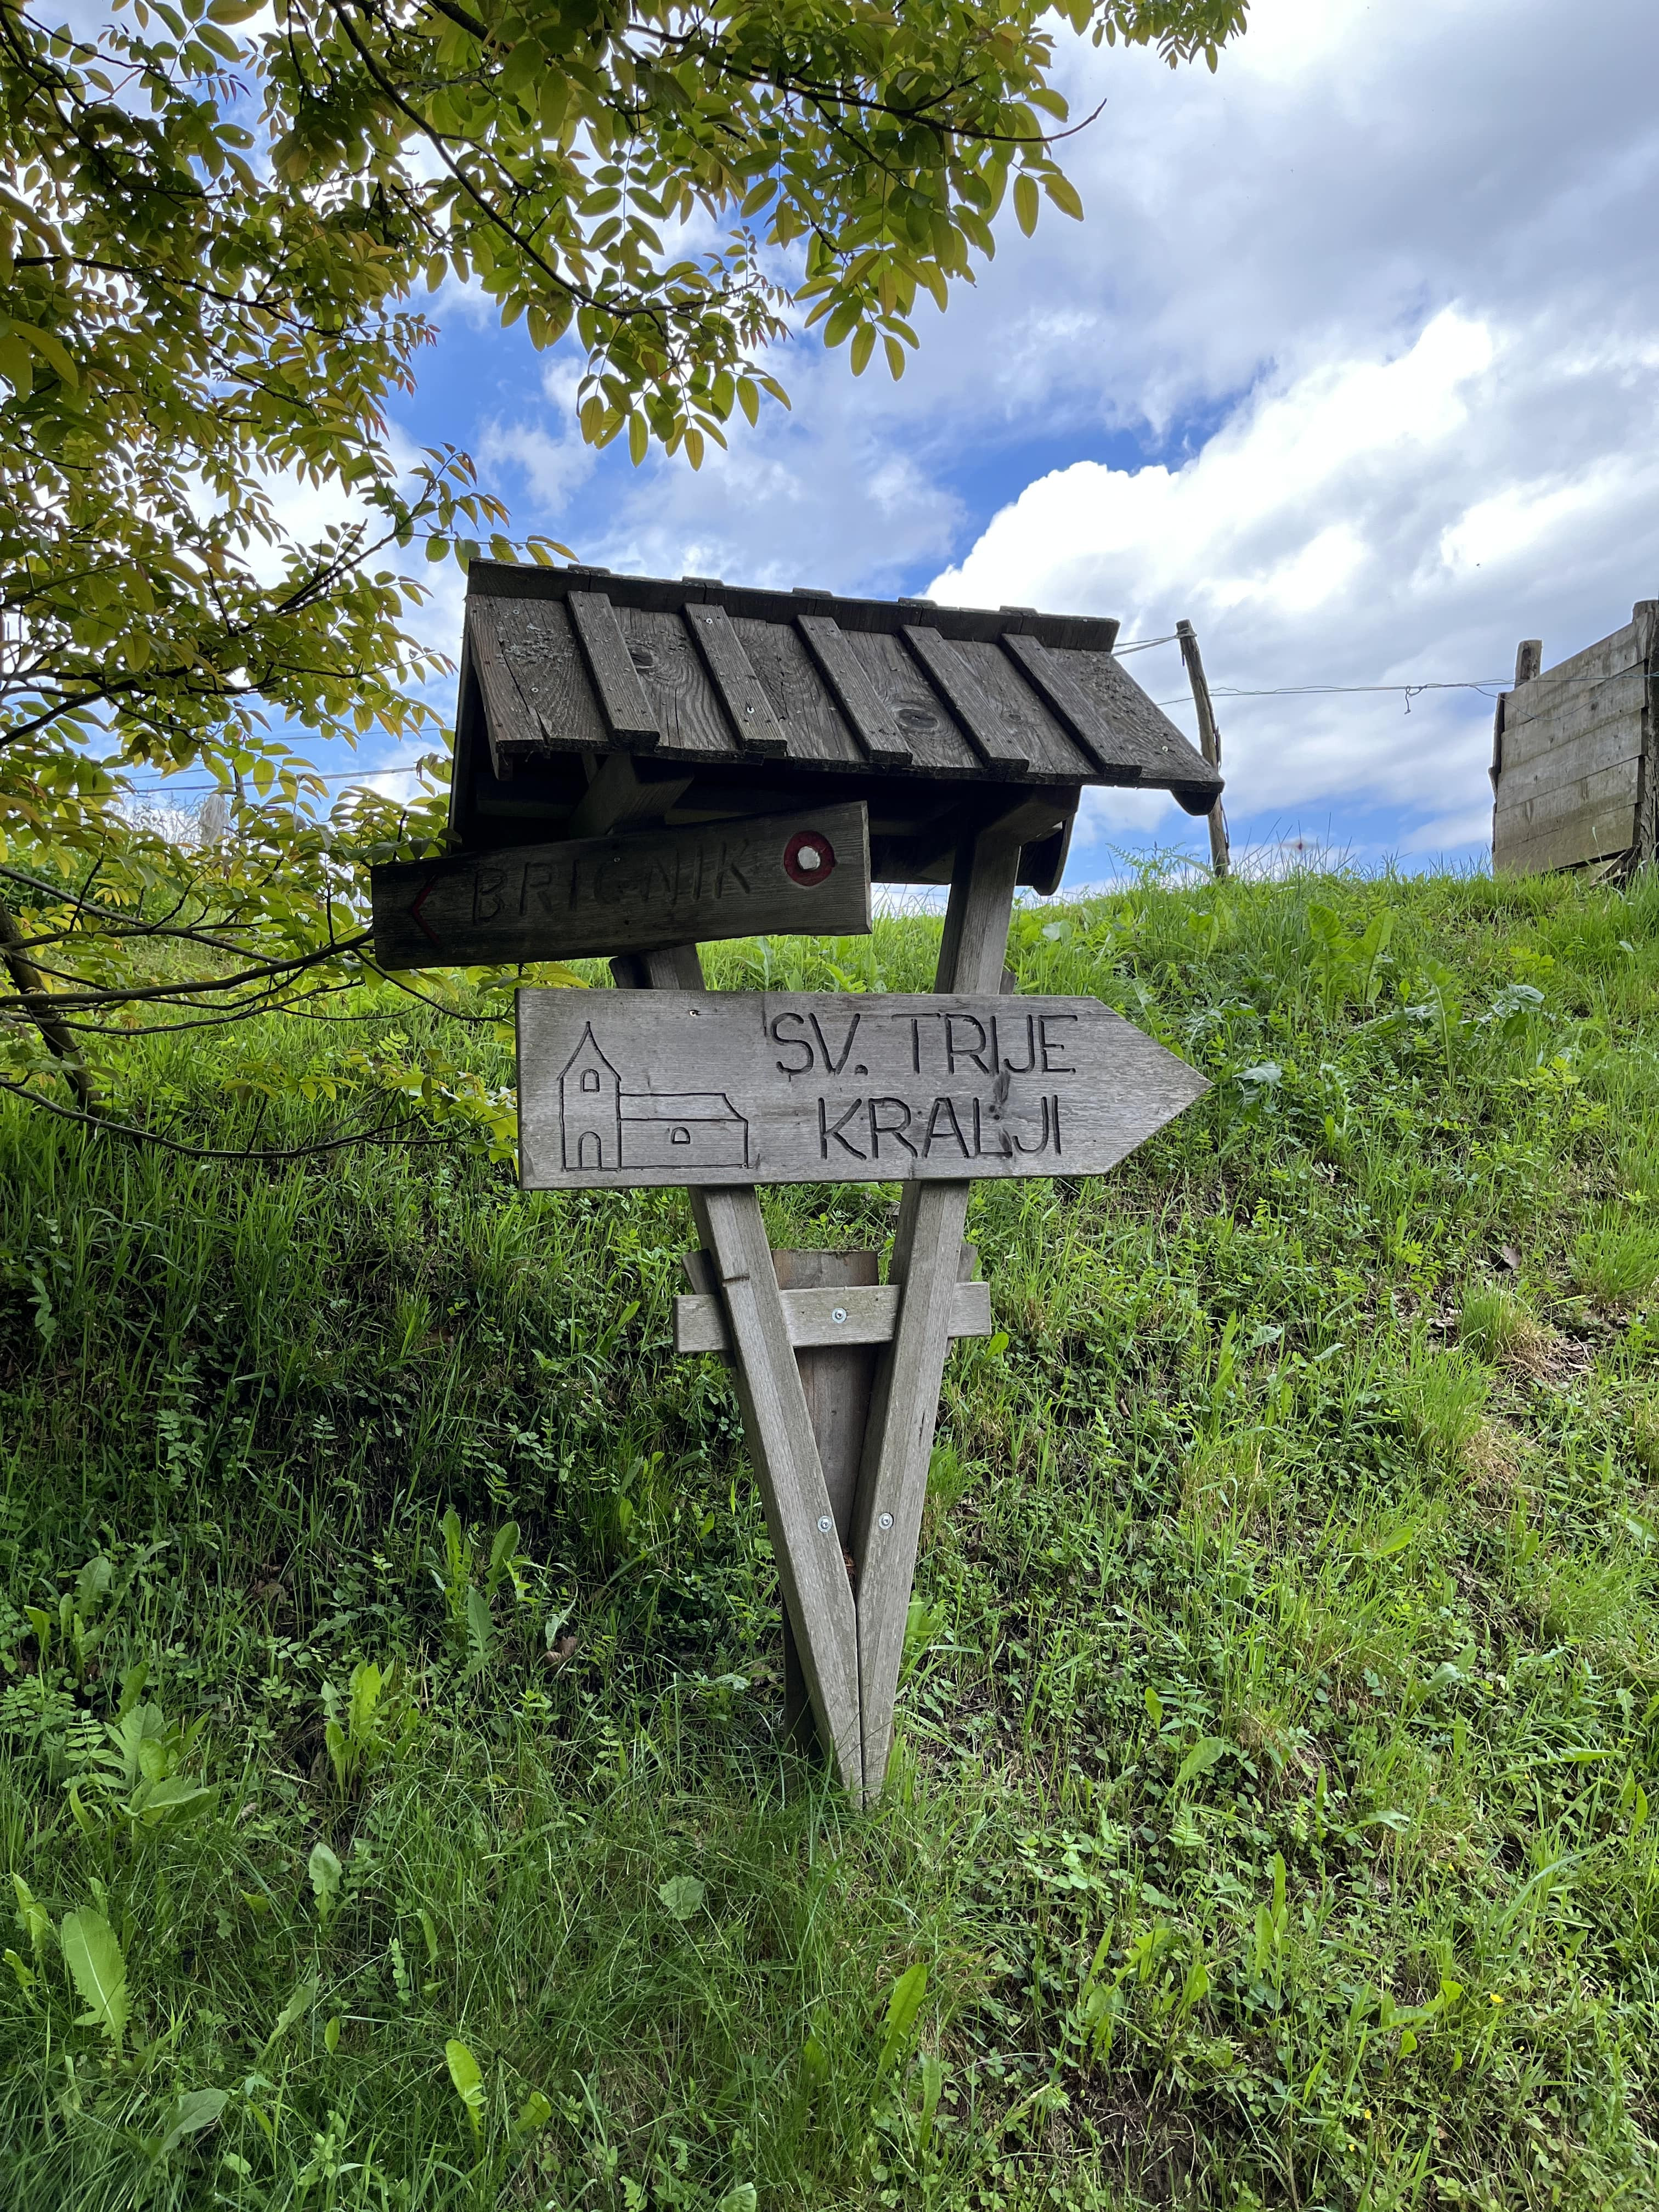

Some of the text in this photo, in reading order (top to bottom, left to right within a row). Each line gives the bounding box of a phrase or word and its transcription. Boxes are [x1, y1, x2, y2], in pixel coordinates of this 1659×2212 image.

[770, 1012, 1079, 1077] SV. TRIJE
[818, 1094, 1062, 1160] KRALJI
